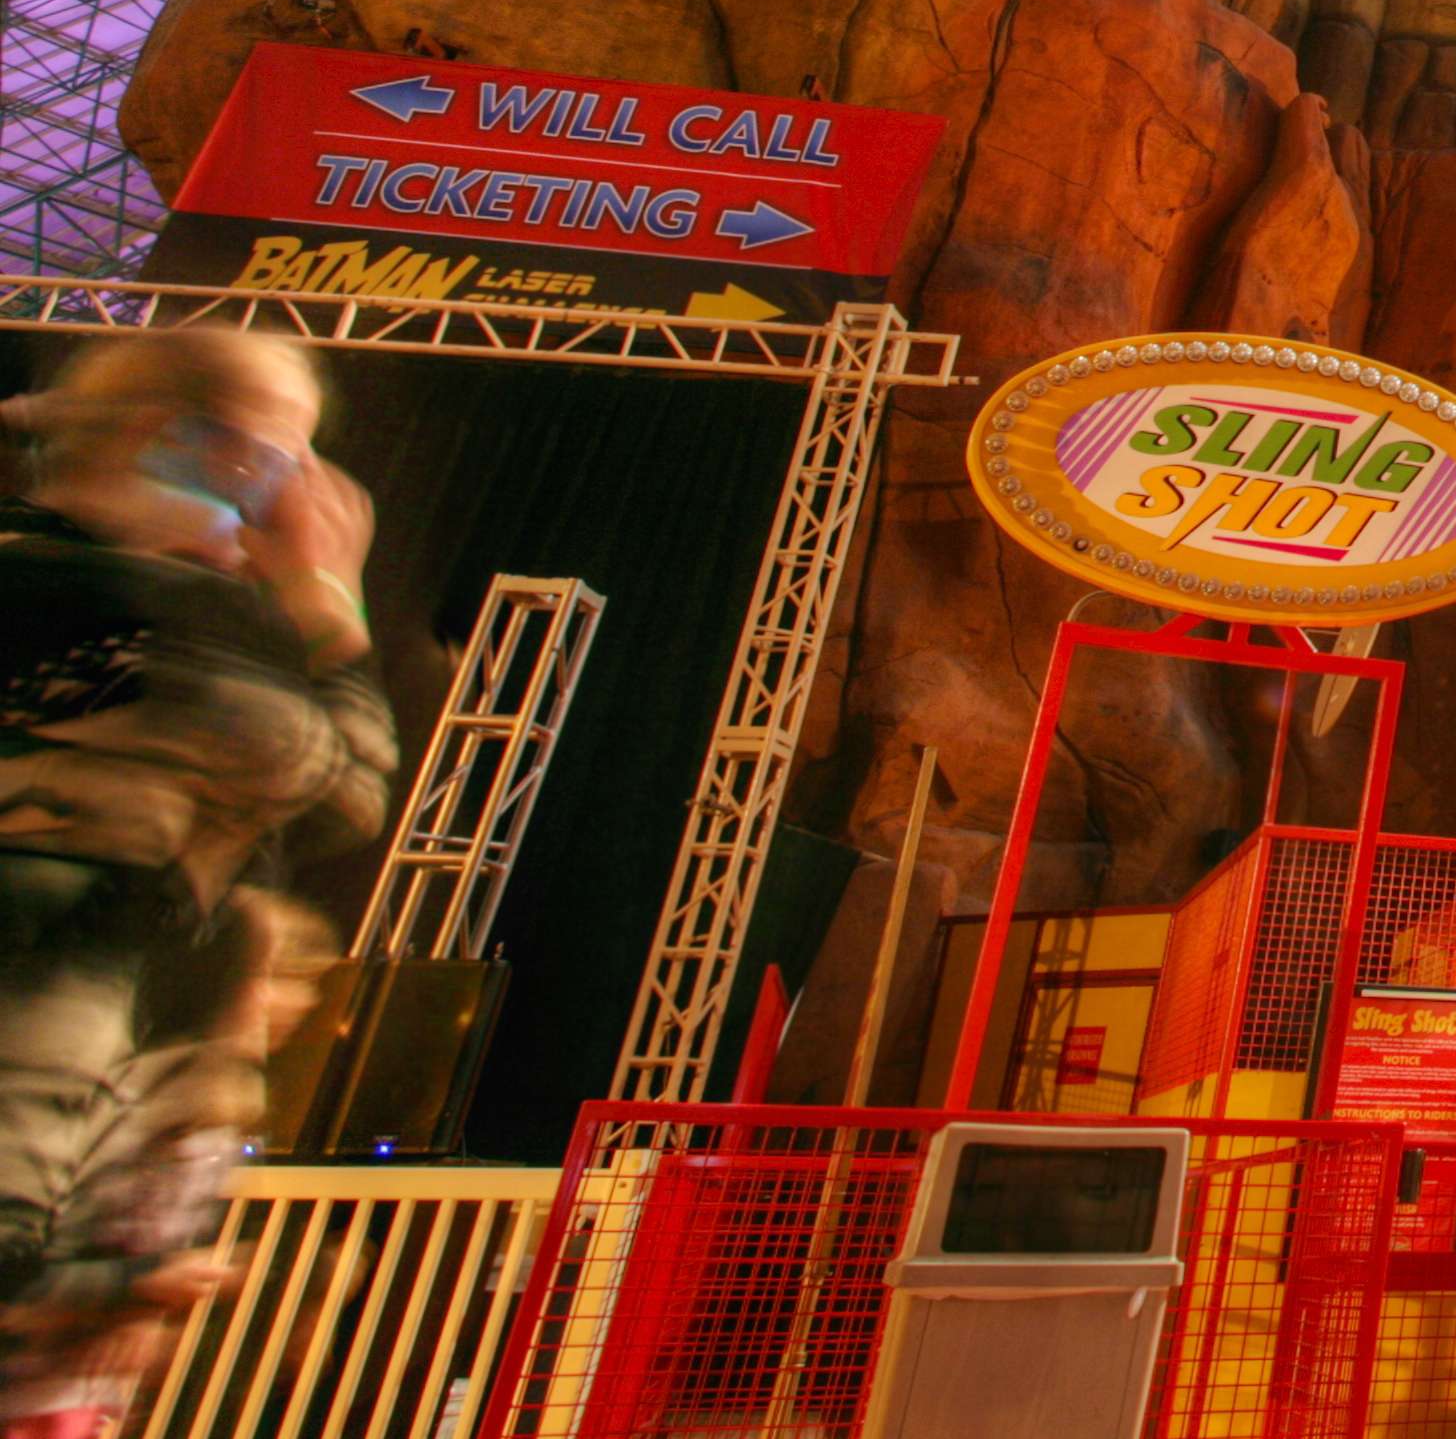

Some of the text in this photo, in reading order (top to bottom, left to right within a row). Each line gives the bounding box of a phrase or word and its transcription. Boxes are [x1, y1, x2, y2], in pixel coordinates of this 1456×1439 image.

[479, 82, 840, 167] WILL CALL
[314, 154, 702, 238] TICKETING
[228, 236, 480, 314] BATMAN
[476, 267, 596, 296] LASER
[1129, 404, 1436, 494] SLING
[1114, 464, 1401, 551] SHOT
[1353, 1006, 1407, 1036] Sling
[1382, 1055, 1421, 1066] NOTICE
[1335, 1108, 1405, 1121] NSTRUCTIONS
[1408, 1110, 1423, 1121] TO
